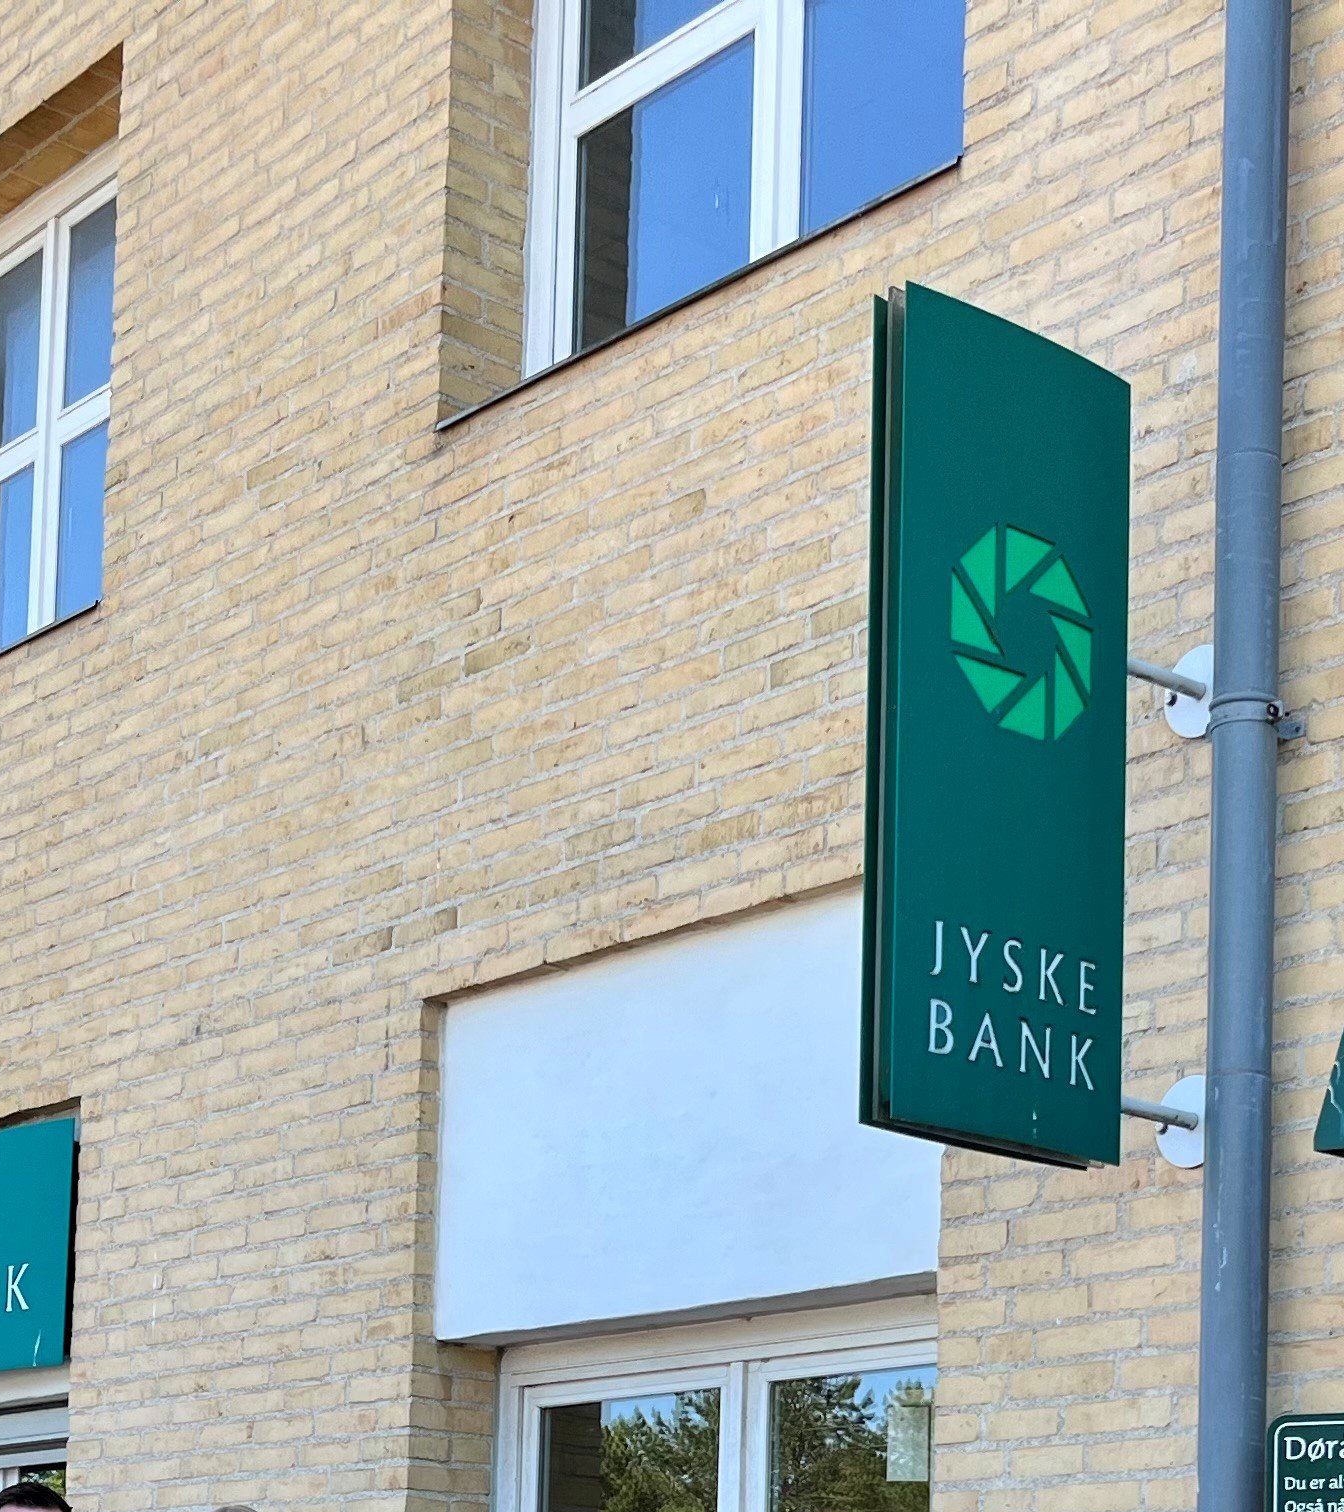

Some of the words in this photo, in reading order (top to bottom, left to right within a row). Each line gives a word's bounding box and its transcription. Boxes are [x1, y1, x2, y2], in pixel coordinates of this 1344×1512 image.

[929, 920, 1097, 1015] JYSKE
[927, 998, 1094, 1091] BANK
[1284, 1476, 1307, 1490] Du
[1309, 1477, 1325, 1489] er
